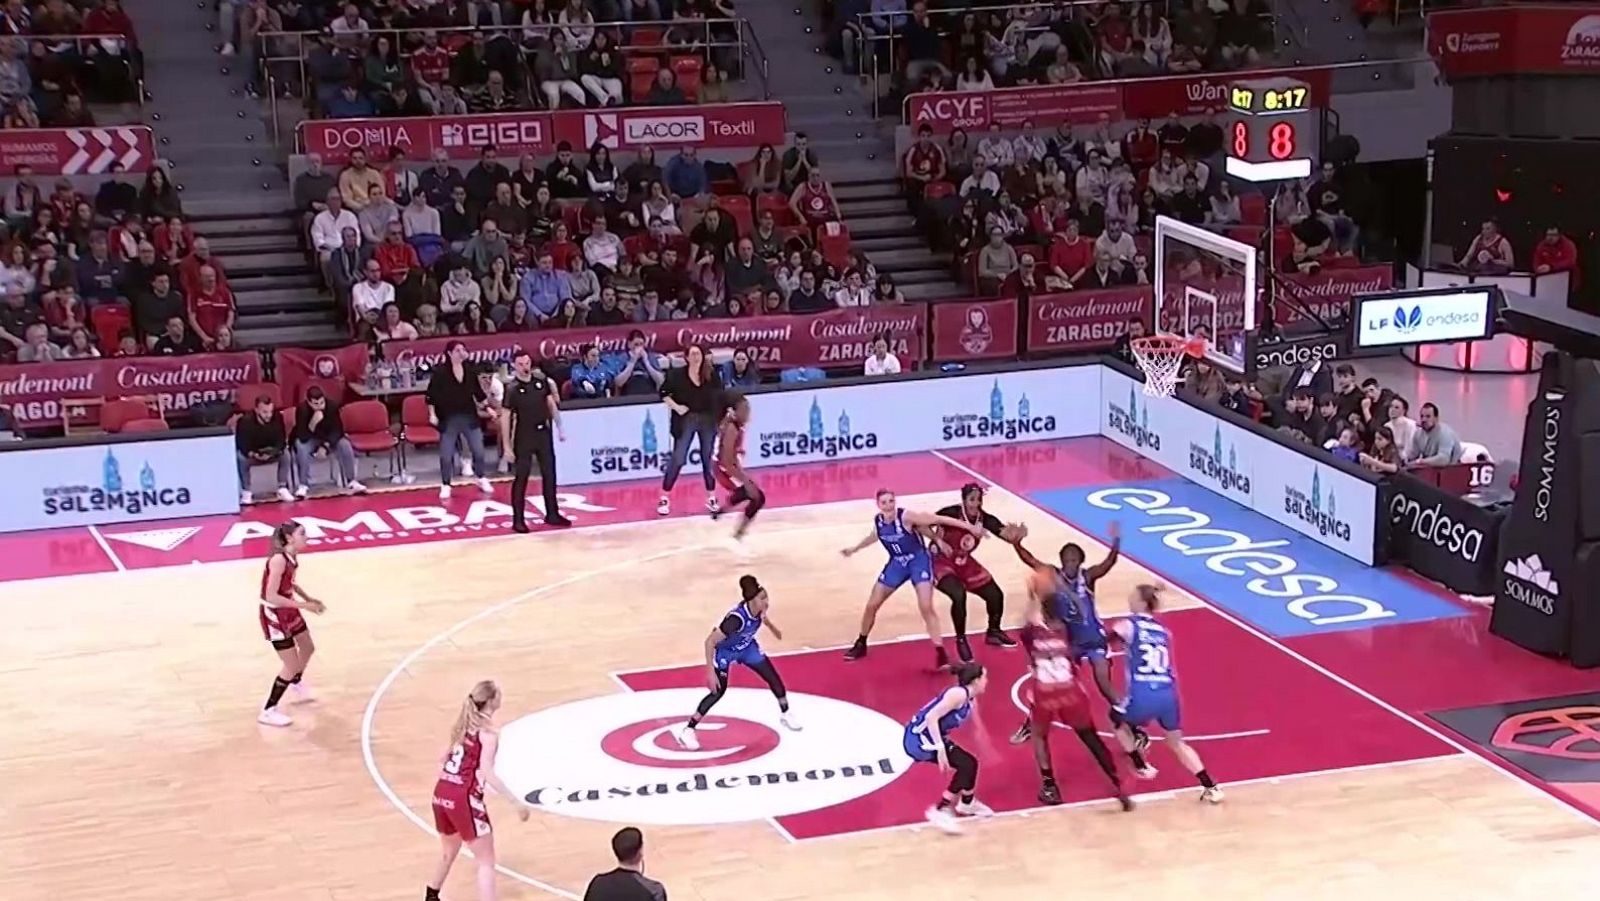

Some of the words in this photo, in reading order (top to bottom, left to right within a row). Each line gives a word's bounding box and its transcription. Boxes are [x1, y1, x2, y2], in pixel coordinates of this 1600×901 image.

[917, 96, 984, 121] ACYF
[1264, 88, 1306, 110] 8:17
[628, 122, 699, 140] LACOR
[709, 119, 755, 136] Textil
[952, 116, 985, 128] GROUP
[324, 125, 412, 149] DOMIA
[1234, 122, 1247, 157] 8
[1271, 123, 1294, 159] 8
[1039, 296, 1145, 321] Casademont
[1369, 318, 1389, 331] LF
[1426, 311, 1480, 327] endesa
[677, 323, 791, 346] Casademont
[810, 315, 917, 339] Casademont
[819, 338, 909, 361] ZARAGZA
[1257, 343, 1337, 369] endesa
[118, 364, 250, 389] Casademont
[942, 413, 978, 423] turismo
[760, 431, 796, 441] turismo
[590, 446, 629, 457] turismo
[1535, 406, 1560, 522] SOMMOS
[1469, 465, 1494, 486] 16
[220, 492, 617, 547] AMBAR
[1389, 492, 1484, 563] endesa
[1086, 487, 1397, 625] endesa
[1504, 579, 1555, 615] SOMMOS
[1137, 643, 1169, 674] 30
[444, 745, 465, 775] 3
[524, 758, 897, 805] Casademont
